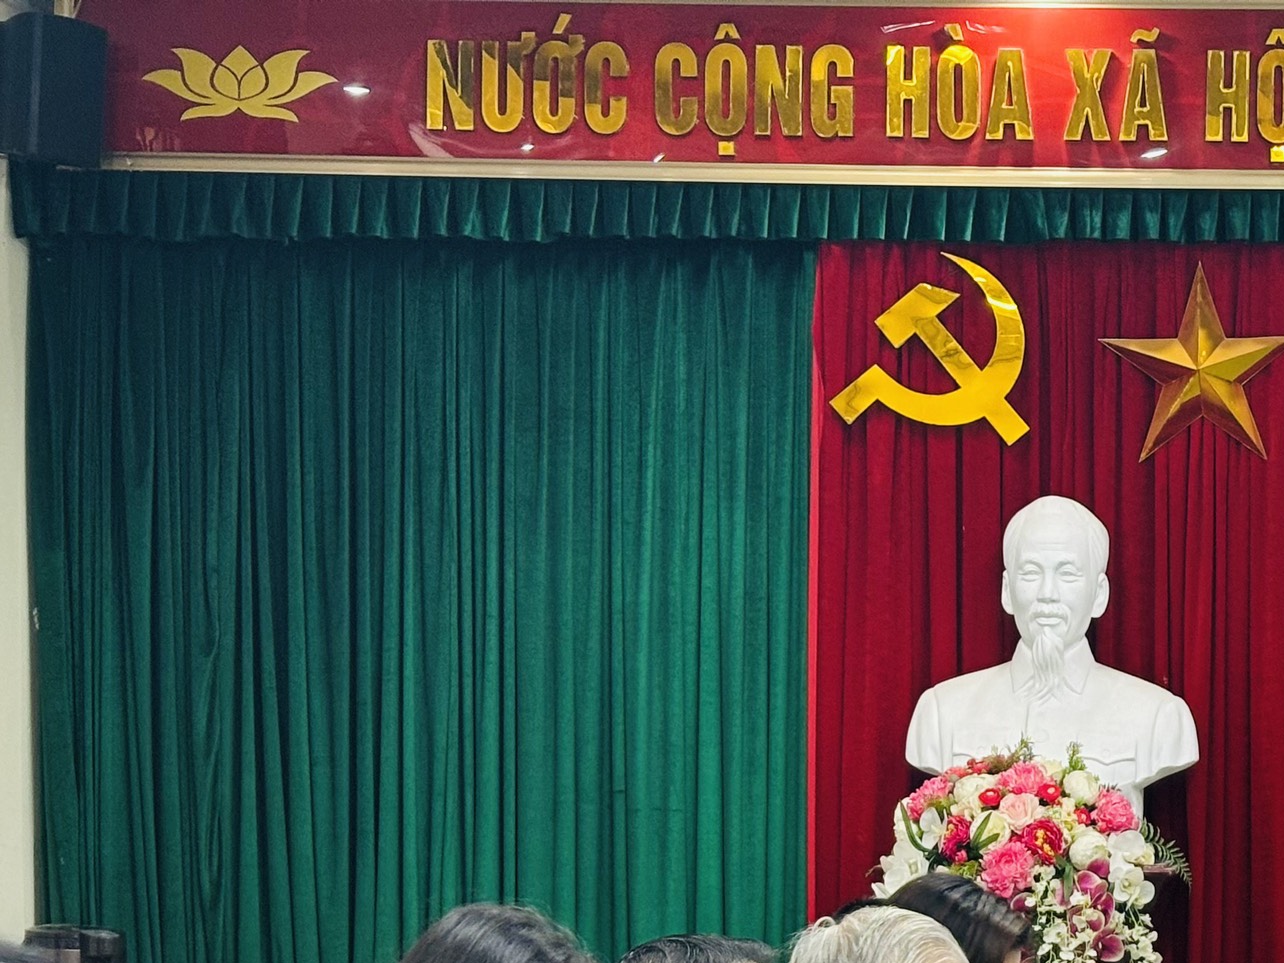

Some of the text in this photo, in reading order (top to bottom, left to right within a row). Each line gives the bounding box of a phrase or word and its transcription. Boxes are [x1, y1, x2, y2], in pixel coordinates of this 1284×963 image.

[427, 13, 630, 135] NƯỚC
[654, 22, 854, 156] CỘNG
[885, 23, 1035, 142] HÒA
[1064, 27, 1169, 142] XÃ
